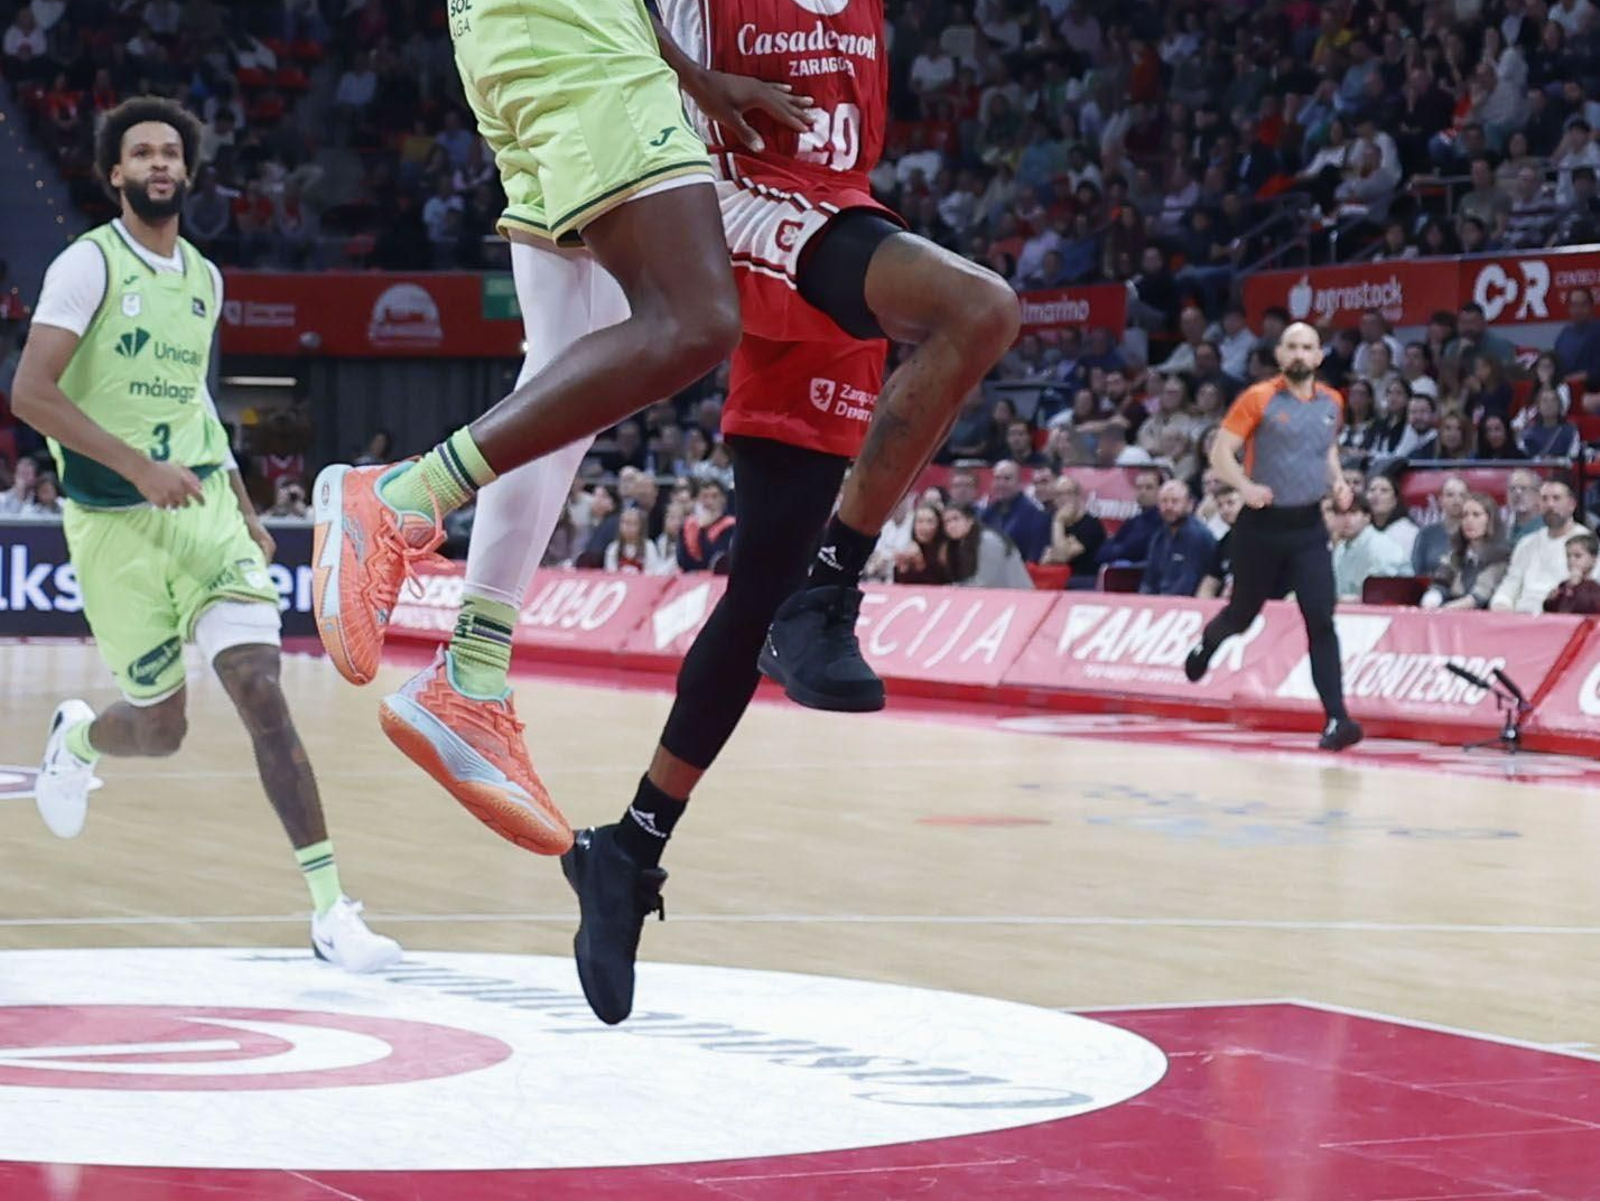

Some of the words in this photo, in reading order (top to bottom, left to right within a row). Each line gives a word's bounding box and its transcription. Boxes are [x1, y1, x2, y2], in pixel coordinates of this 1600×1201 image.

[796, 103, 860, 172] 20
[154, 341, 201, 367] Unica
[151, 422, 171, 462] 3
[1073, 607, 1266, 672] AMBR
